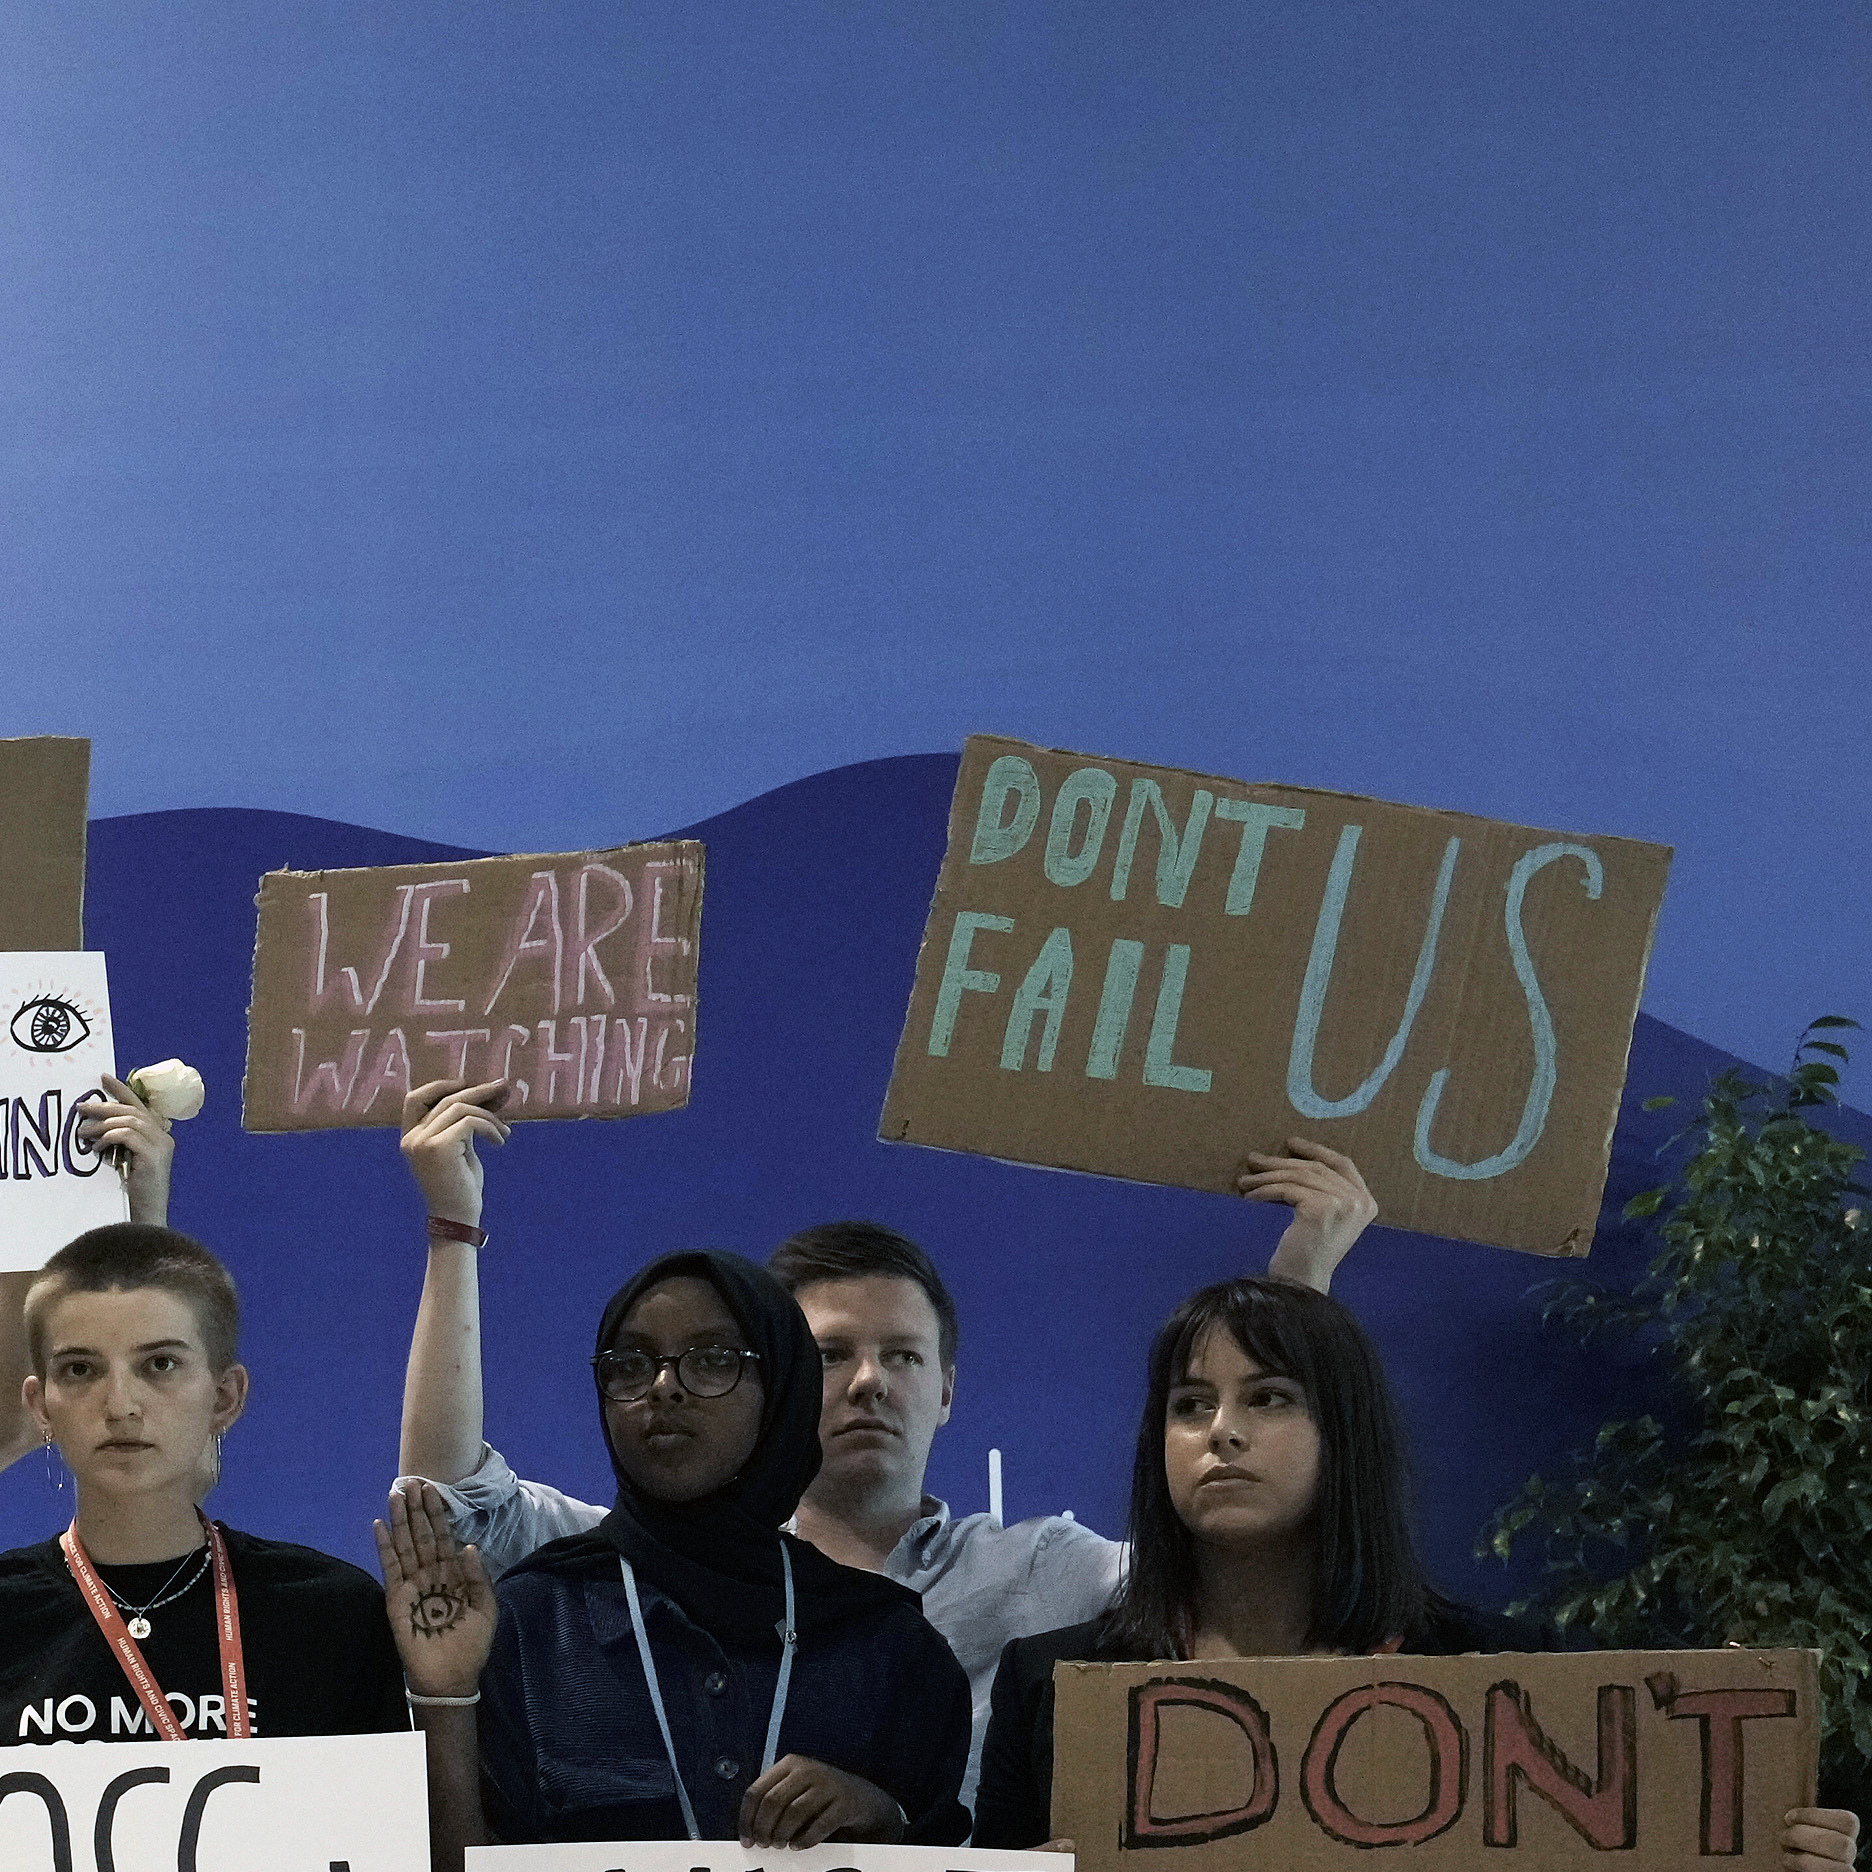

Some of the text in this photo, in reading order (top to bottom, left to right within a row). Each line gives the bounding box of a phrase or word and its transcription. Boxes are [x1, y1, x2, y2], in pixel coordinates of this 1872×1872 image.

[969, 755, 1305, 916] DONT
[308, 858, 697, 1017] WE ARE
[927, 910, 1214, 1093] FAIL
[1286, 824, 1604, 1181] US
[290, 1014, 693, 1115] WATCHING
[80, 1566, 97, 1594] CLIMATE
[94, 1593, 110, 1619] ACTION
[222, 1587, 230, 1613] RIGHTS
[224, 1613, 232, 1641] HUMAN
[19, 1692, 257, 1736] NO MORE
[117, 1637, 135, 1663] HUMAN
[131, 1662, 149, 1689] RIGHTS
[146, 1687, 158, 1705] AND
[155, 1704, 169, 1724] CIVIC
[228, 1661, 236, 1689] ACTION
[230, 1688, 239, 1721] CLIMATE
[1118, 1672, 1797, 1858] DON'T
